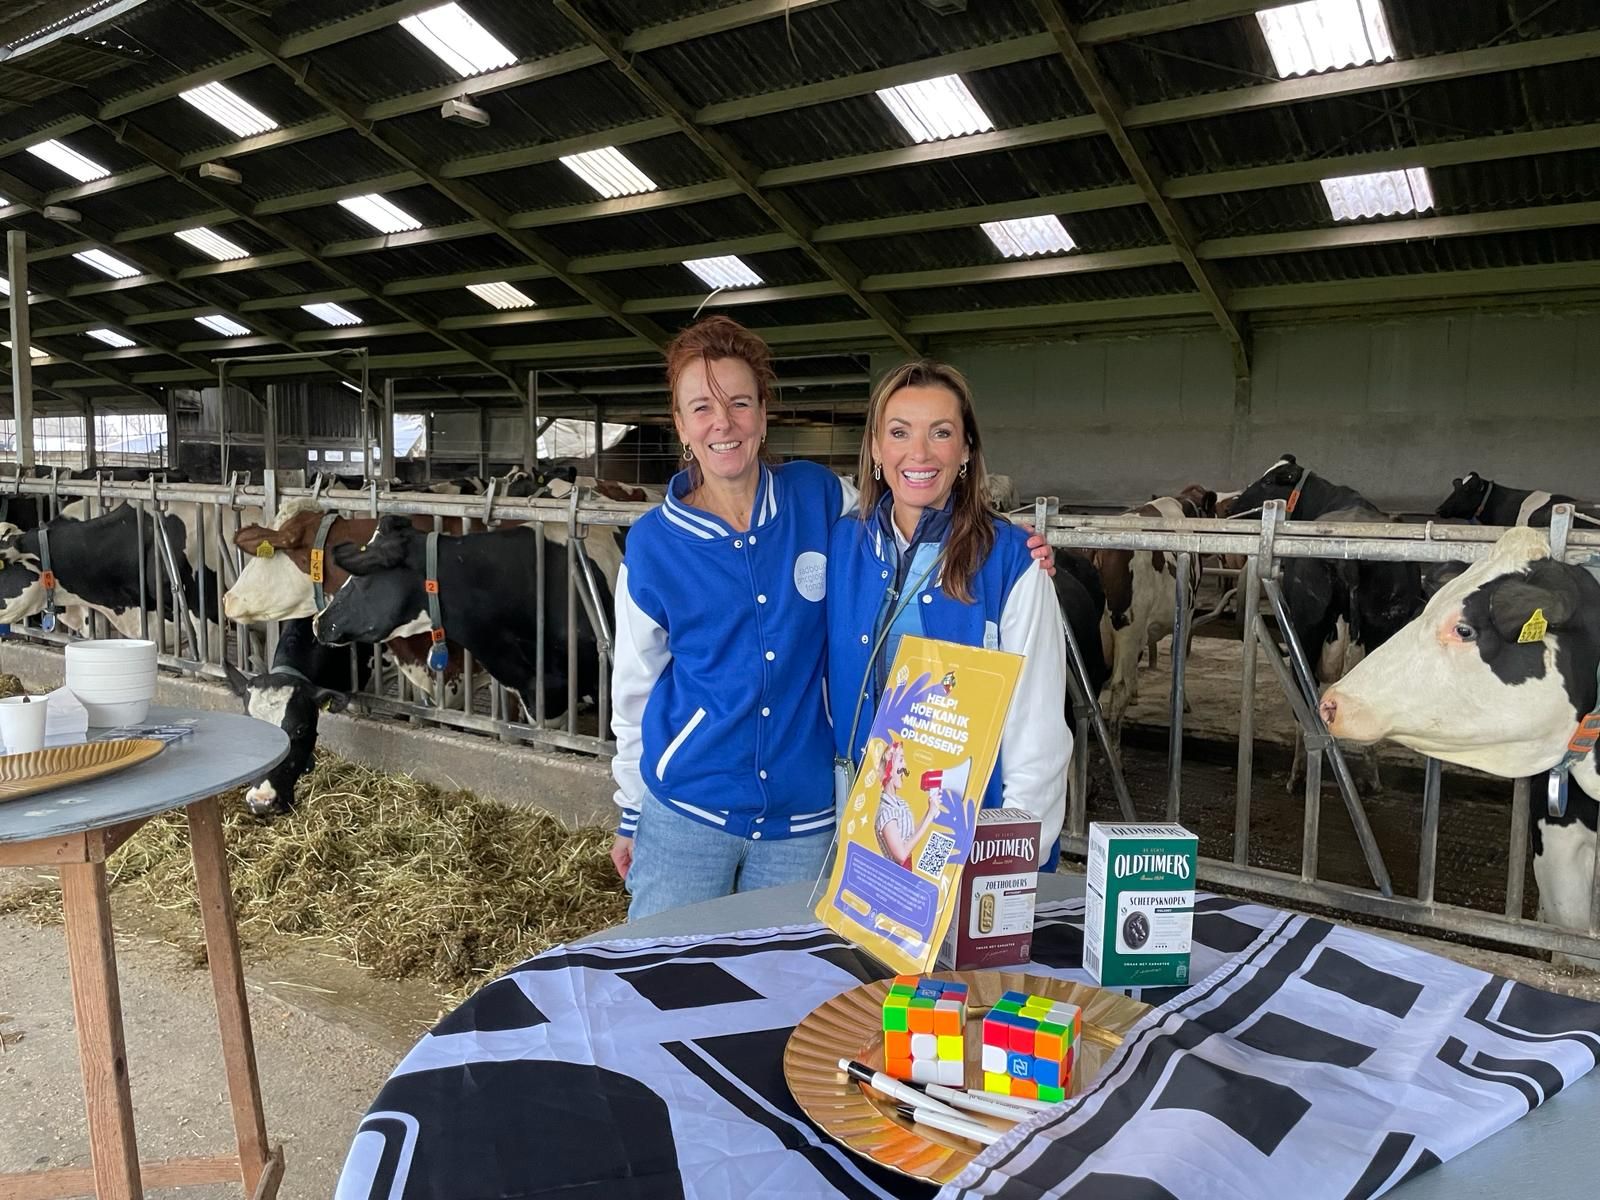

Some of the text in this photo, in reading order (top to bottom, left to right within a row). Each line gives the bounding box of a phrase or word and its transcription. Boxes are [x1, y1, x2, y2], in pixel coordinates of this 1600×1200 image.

[427, 582, 435, 592] 2
[926, 693, 958, 711] HELP!
[910, 702, 970, 729] HOE KAN IK
[902, 714, 969, 743] MIJN KUBUS
[900, 727, 965, 756] OPLOSSEN?
[1111, 826, 1187, 837] OLDTIMERS
[970, 837, 1035, 865] OLDTIMERS
[1114, 854, 1190, 880] OLDTIMERS
[985, 878, 1028, 890] ZOETHOUDERS
[1130, 896, 1186, 906] SCHEEPSKNOPEN
